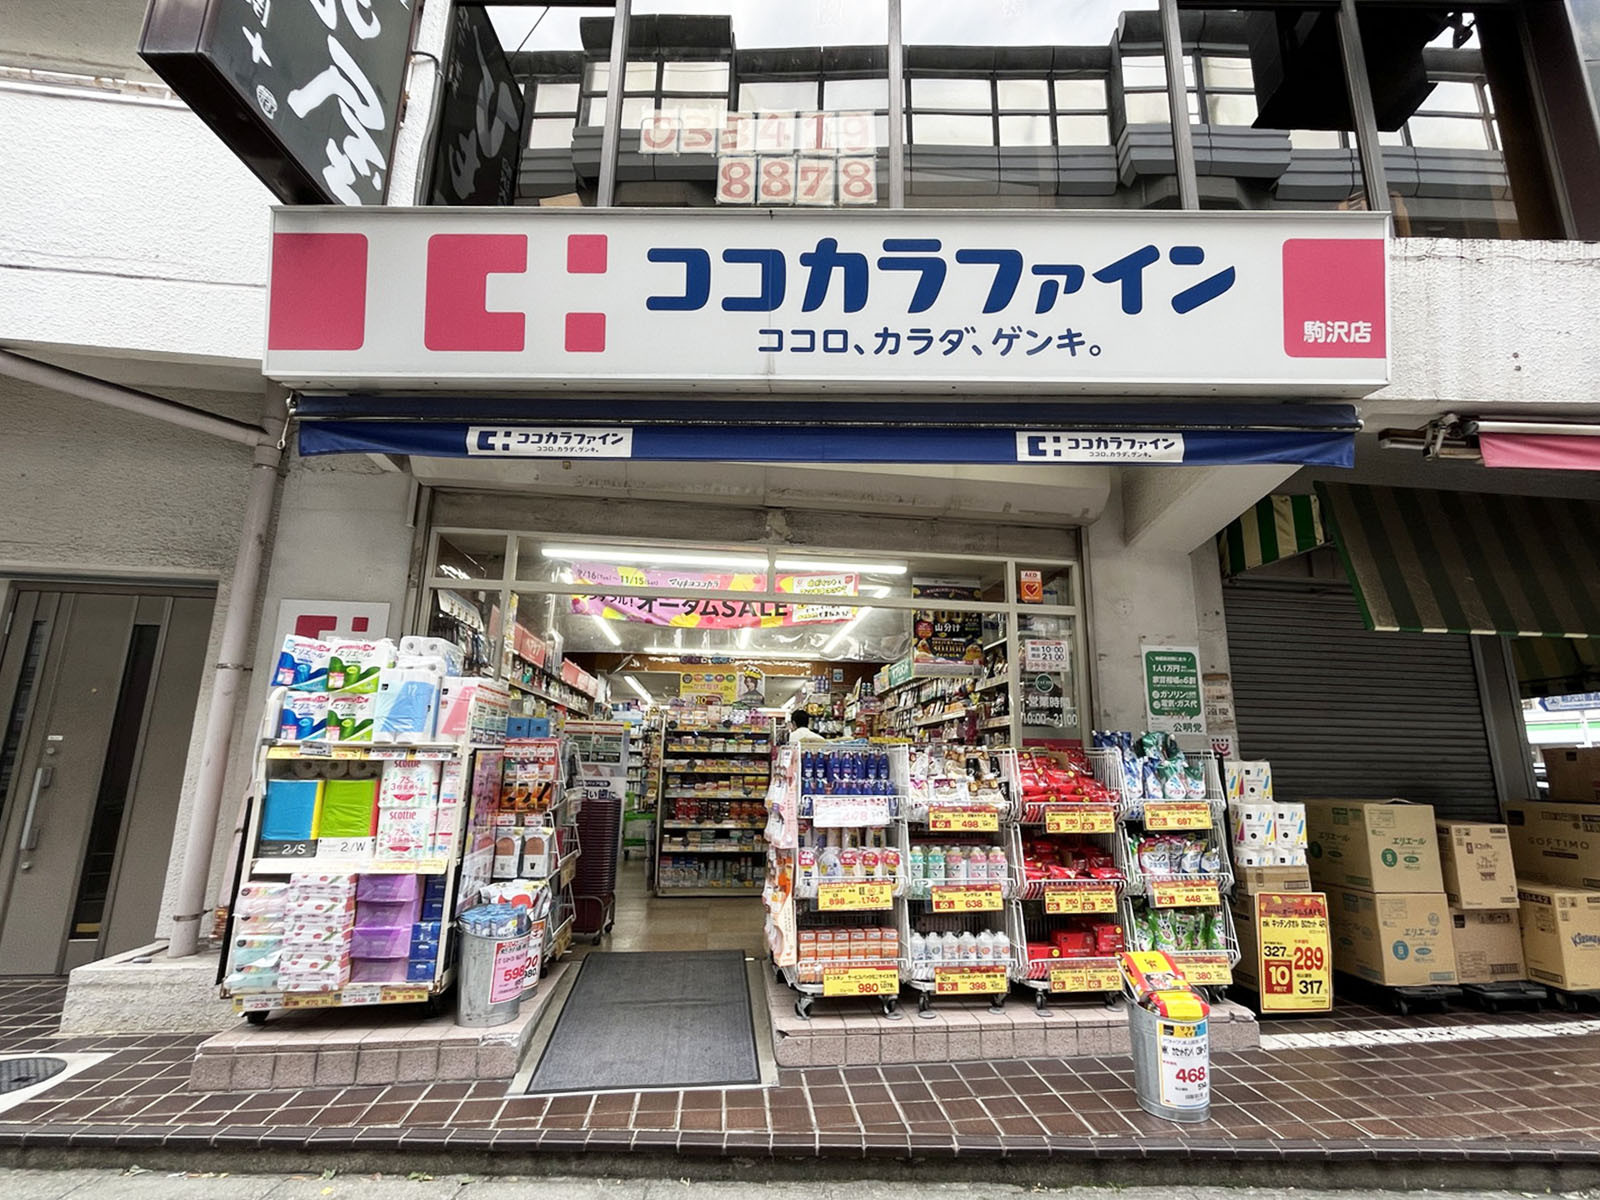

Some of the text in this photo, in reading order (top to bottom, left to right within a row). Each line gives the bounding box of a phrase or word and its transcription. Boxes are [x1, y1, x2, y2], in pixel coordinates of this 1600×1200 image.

[721, 161, 873, 198] 8878
[646, 237, 1236, 316] ココカラファイン
[1302, 319, 1373, 345] 駒沢店
[758, 327, 1103, 358] ココロ、カラダ、ゲンキ。
[517, 431, 624, 445] ココカラファイン
[1067, 436, 1175, 450] ココカラファイン
[934, 622, 961, 633] 山分け
[1173, 722, 1203, 733] 公明党
[961, 820, 979, 828] 498
[1392, 836, 1426, 846] エリエール
[965, 899, 983, 908] 638
[1185, 895, 1202, 903] 448
[1403, 927, 1439, 937] エリエール
[1264, 945, 1287, 957] 327
[1294, 946, 1324, 971] 289
[504, 964, 525, 982] 598
[1195, 971, 1212, 980] 380
[1268, 965, 1291, 985] 10
[857, 983, 879, 993] 980
[969, 981, 987, 990] 398
[1298, 979, 1323, 995] 317
[1175, 1065, 1206, 1083] 468
